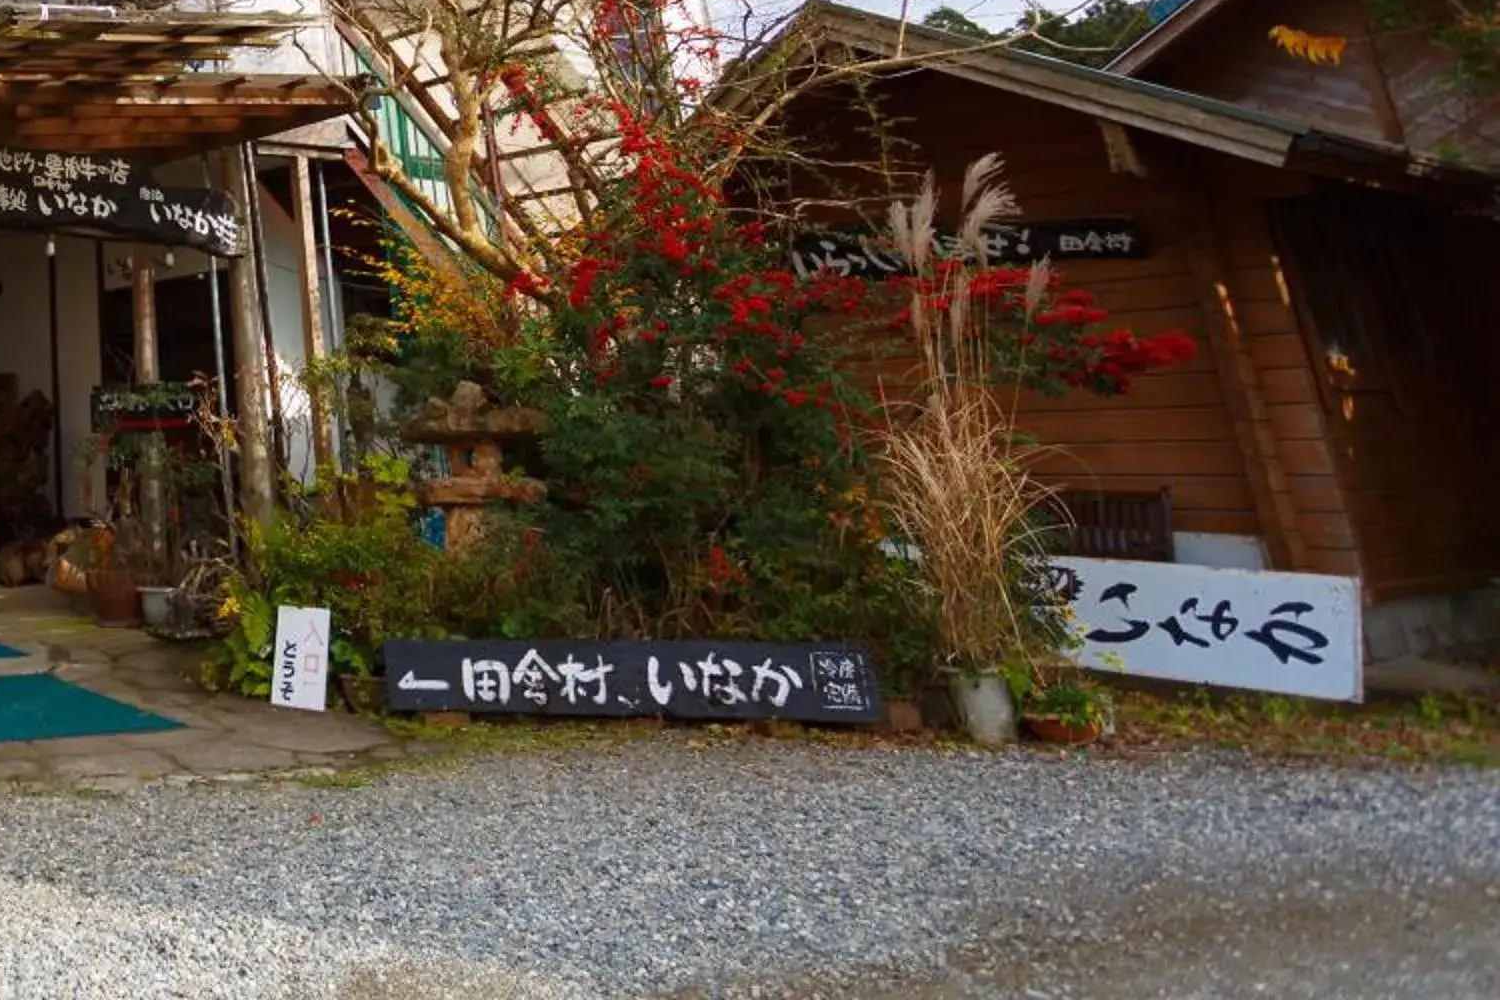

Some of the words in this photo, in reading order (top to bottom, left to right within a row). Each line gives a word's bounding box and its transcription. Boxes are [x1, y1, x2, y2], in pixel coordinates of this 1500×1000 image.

[37, 191, 118, 218] いなか
[1086, 582, 1329, 665] いなか
